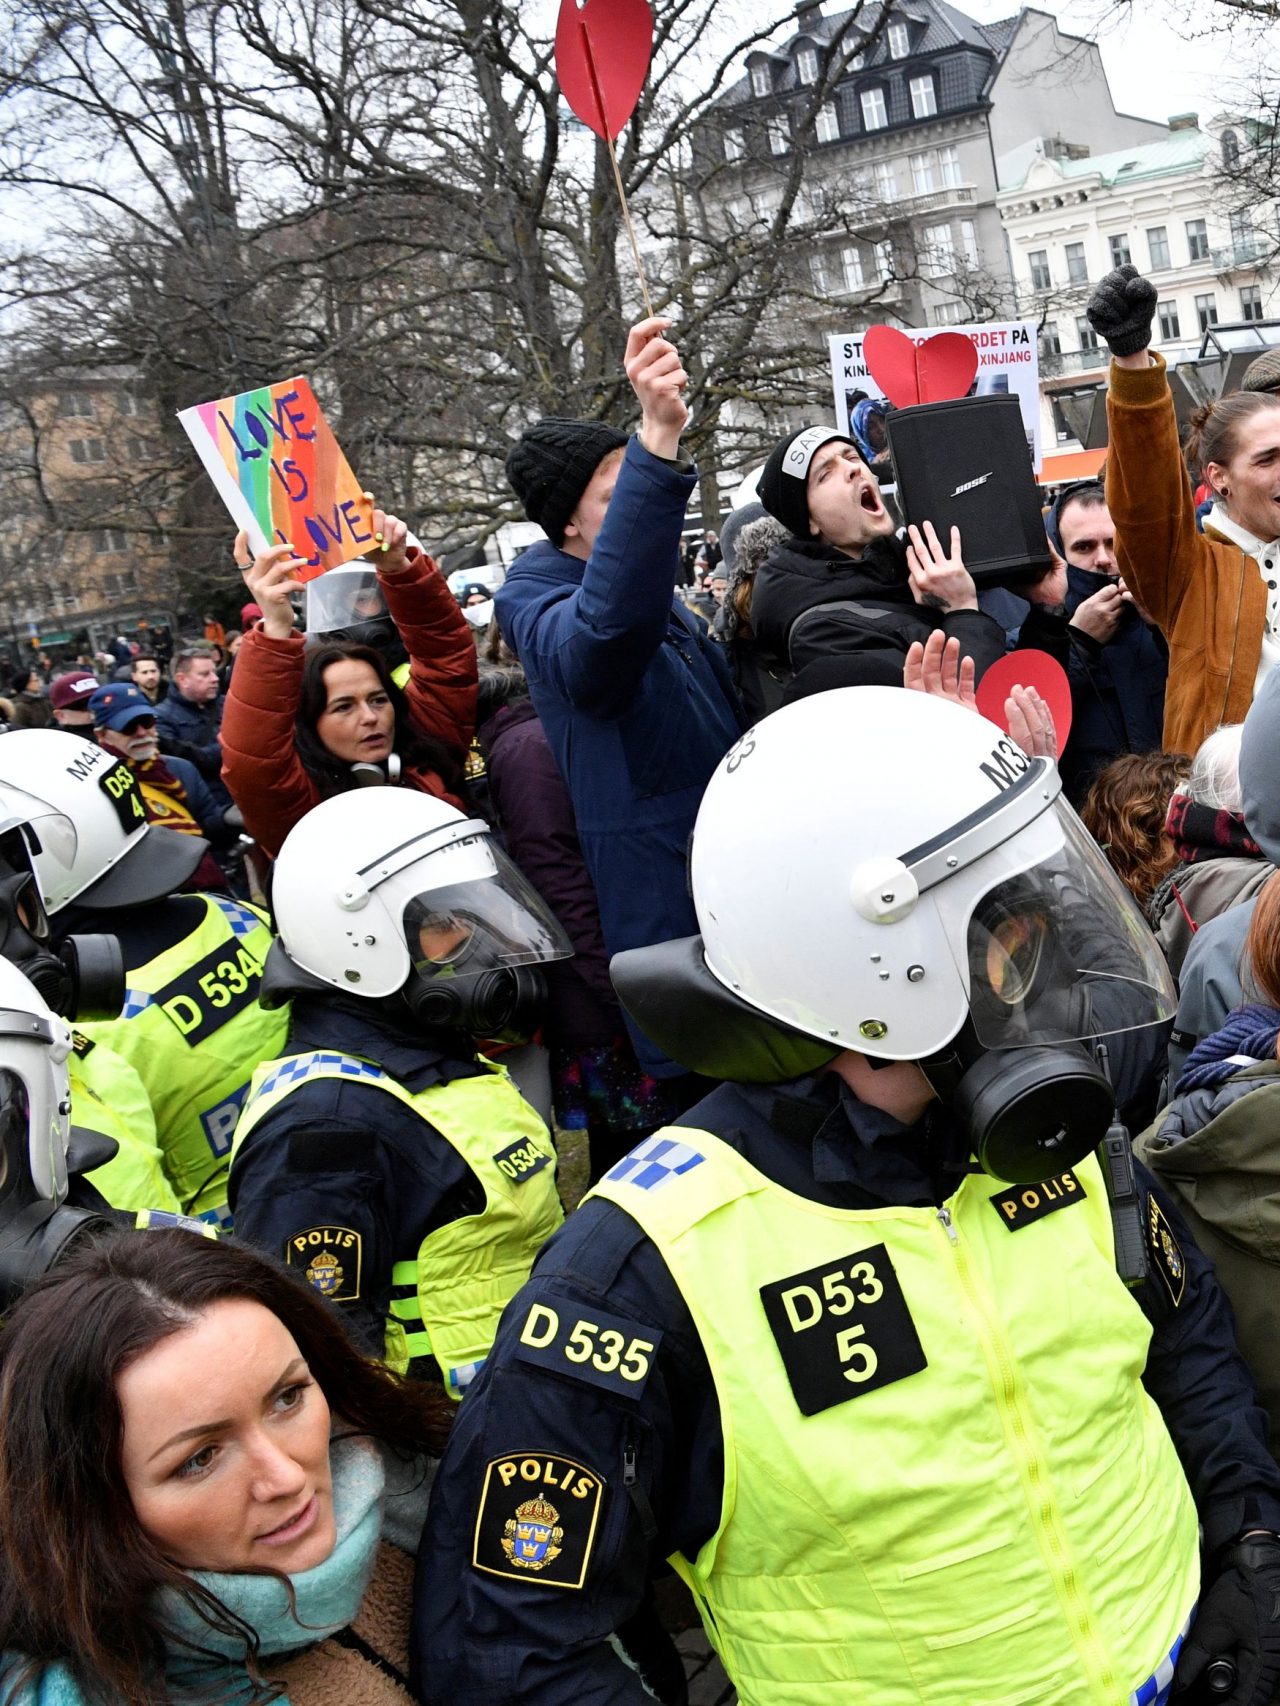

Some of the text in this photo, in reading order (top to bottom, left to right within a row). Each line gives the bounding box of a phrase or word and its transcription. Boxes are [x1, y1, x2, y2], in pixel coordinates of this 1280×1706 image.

[844, 342, 863, 359] ST
[1012, 326, 1030, 345] PÅ
[844, 350, 1031, 378] KIN XINJIANG
[218, 391, 316, 462] LOVE
[270, 458, 308, 502] IS
[952, 473, 991, 497] BOSE
[276, 500, 371, 566] LOVE
[66, 741, 104, 782] M44
[104, 765, 134, 799] D53
[980, 733, 1032, 792] M3
[131, 793, 145, 817] 4
[162, 948, 264, 1036] D 534
[1001, 1173, 1077, 1221] POLIS
[294, 1231, 355, 1252] POLIS
[781, 1261, 884, 1333] D53
[519, 1304, 654, 1382] D 535
[836, 1324, 878, 1383] 5
[498, 1460, 595, 1499] POLIS
